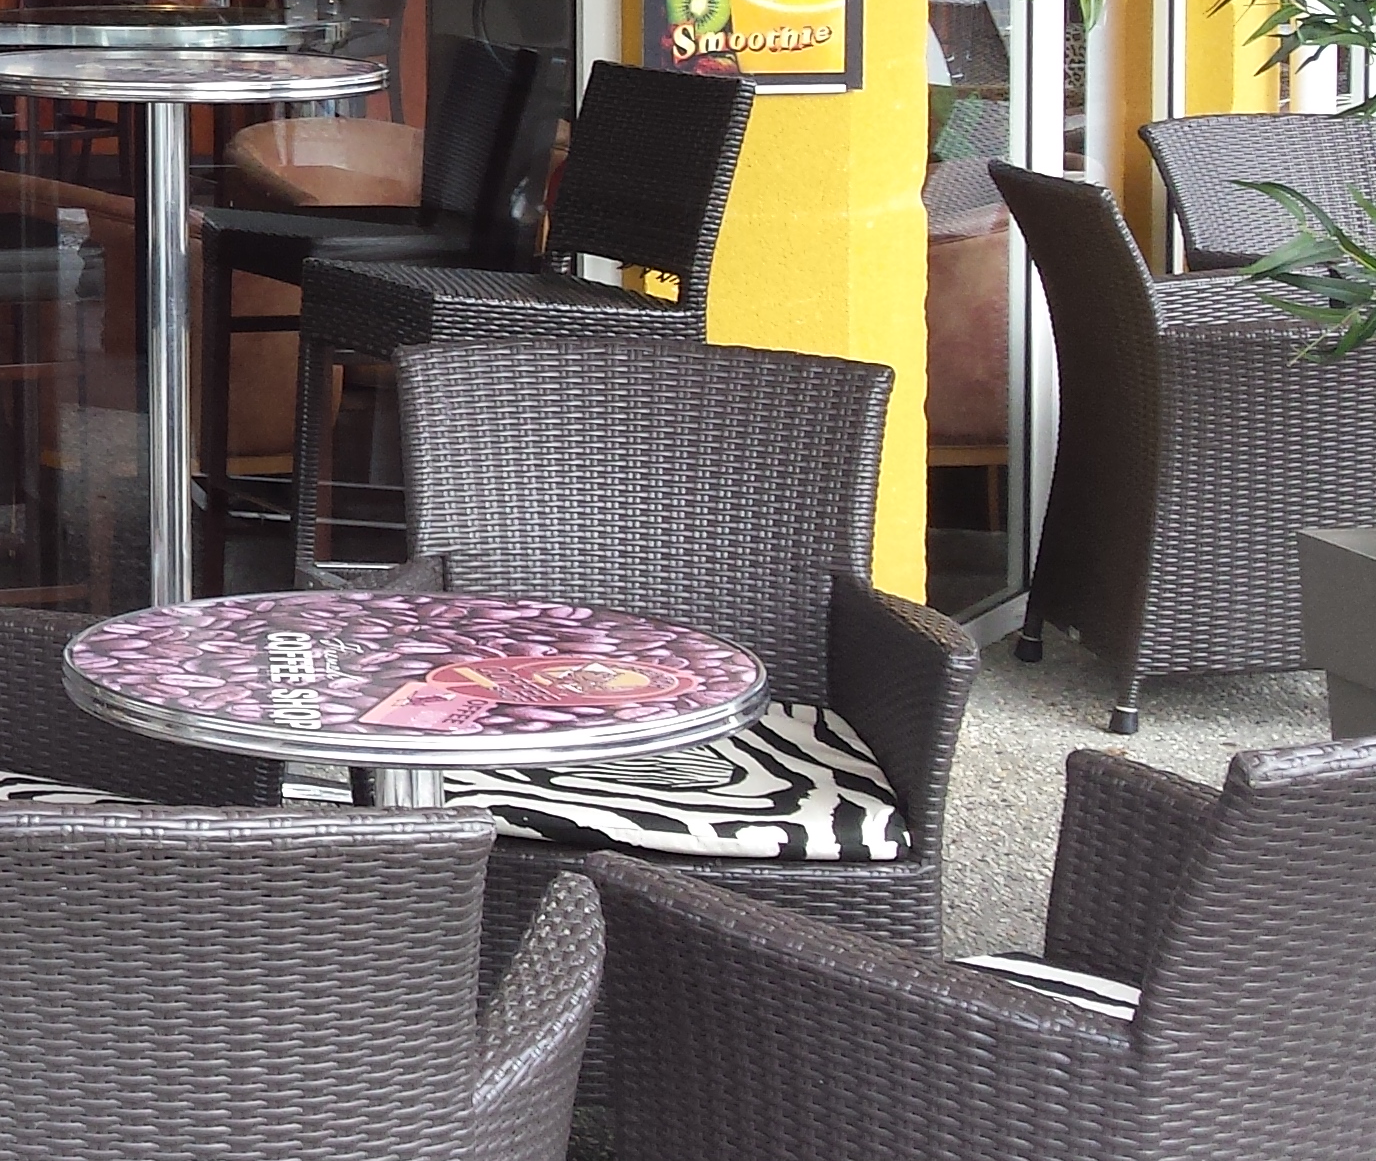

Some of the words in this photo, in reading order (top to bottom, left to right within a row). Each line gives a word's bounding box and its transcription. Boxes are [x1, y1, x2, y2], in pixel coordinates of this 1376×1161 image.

[672, 22, 833, 64] Smoothie
[266, 631, 317, 684] COFFEE
[270, 688, 323, 731] SHOP
